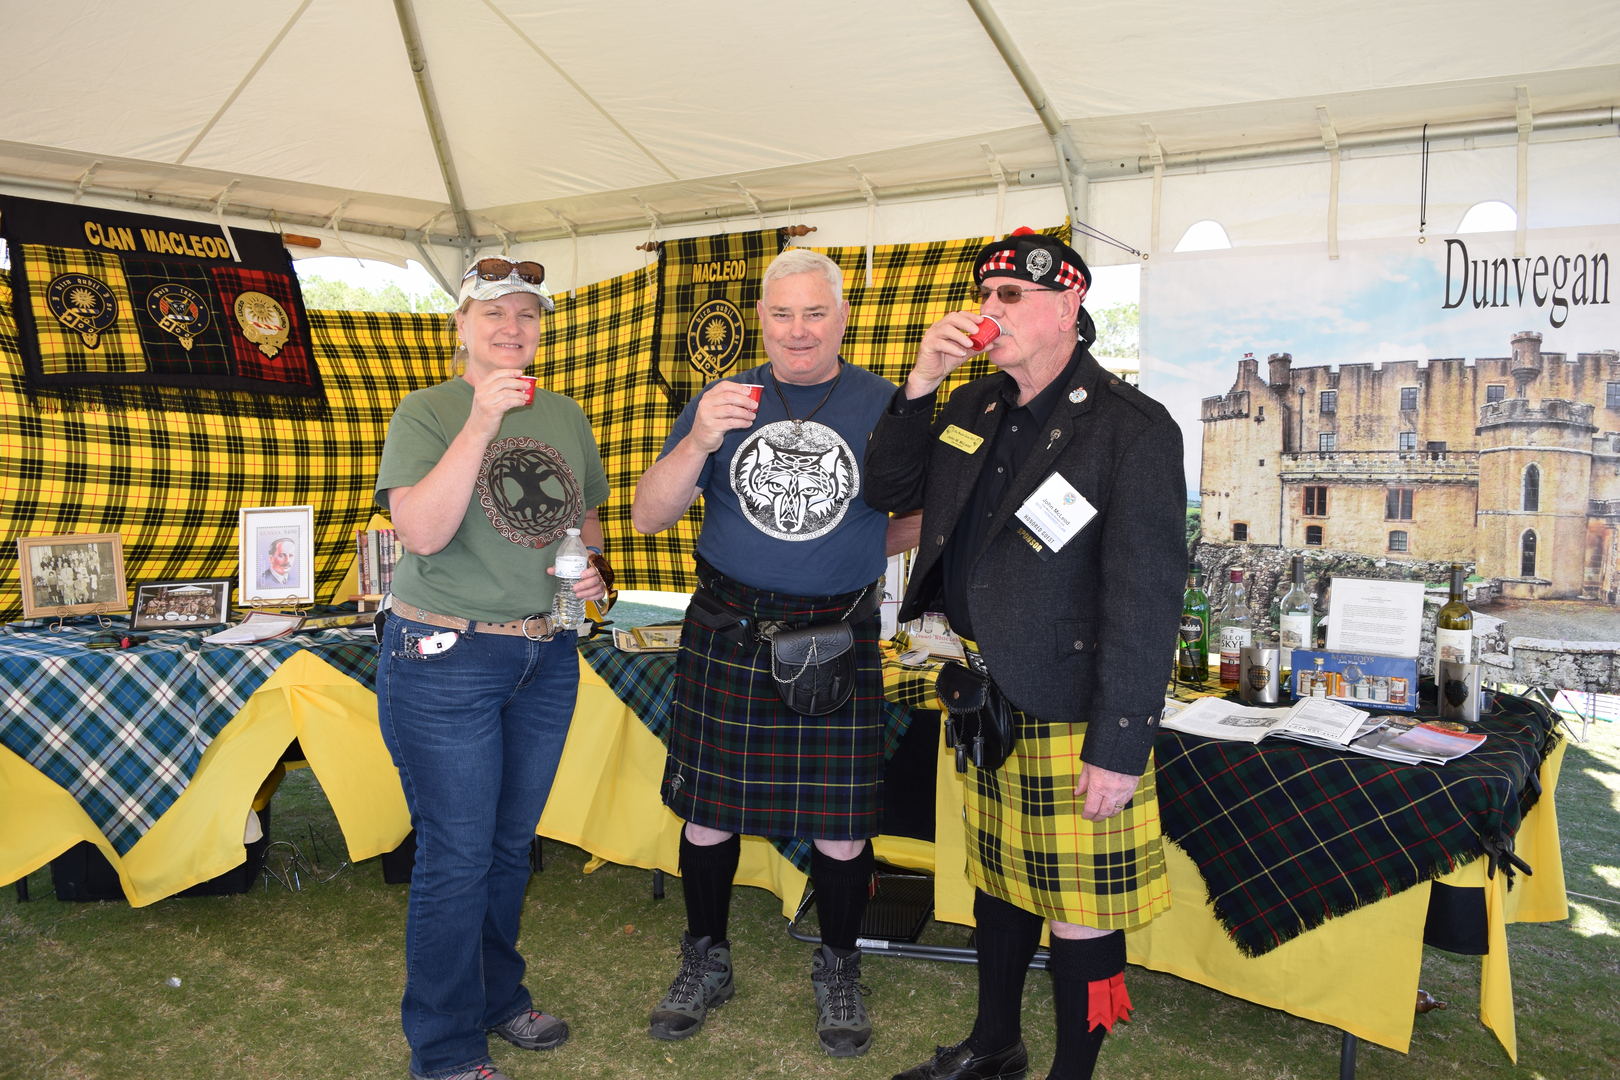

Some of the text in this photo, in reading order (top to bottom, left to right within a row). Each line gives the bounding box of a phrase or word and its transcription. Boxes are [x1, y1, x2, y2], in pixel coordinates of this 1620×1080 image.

[84, 221, 230, 259] CLAN MACLEOD
[692, 260, 746, 282] MACLEOD
[1442, 239, 1610, 328] Dunvegan
[273, 304, 283, 317] NON
[1042, 498, 1054, 510] John
[1016, 527, 1043, 553] SPONSOR
[1023, 514, 1055, 544] HONORED GUEST
